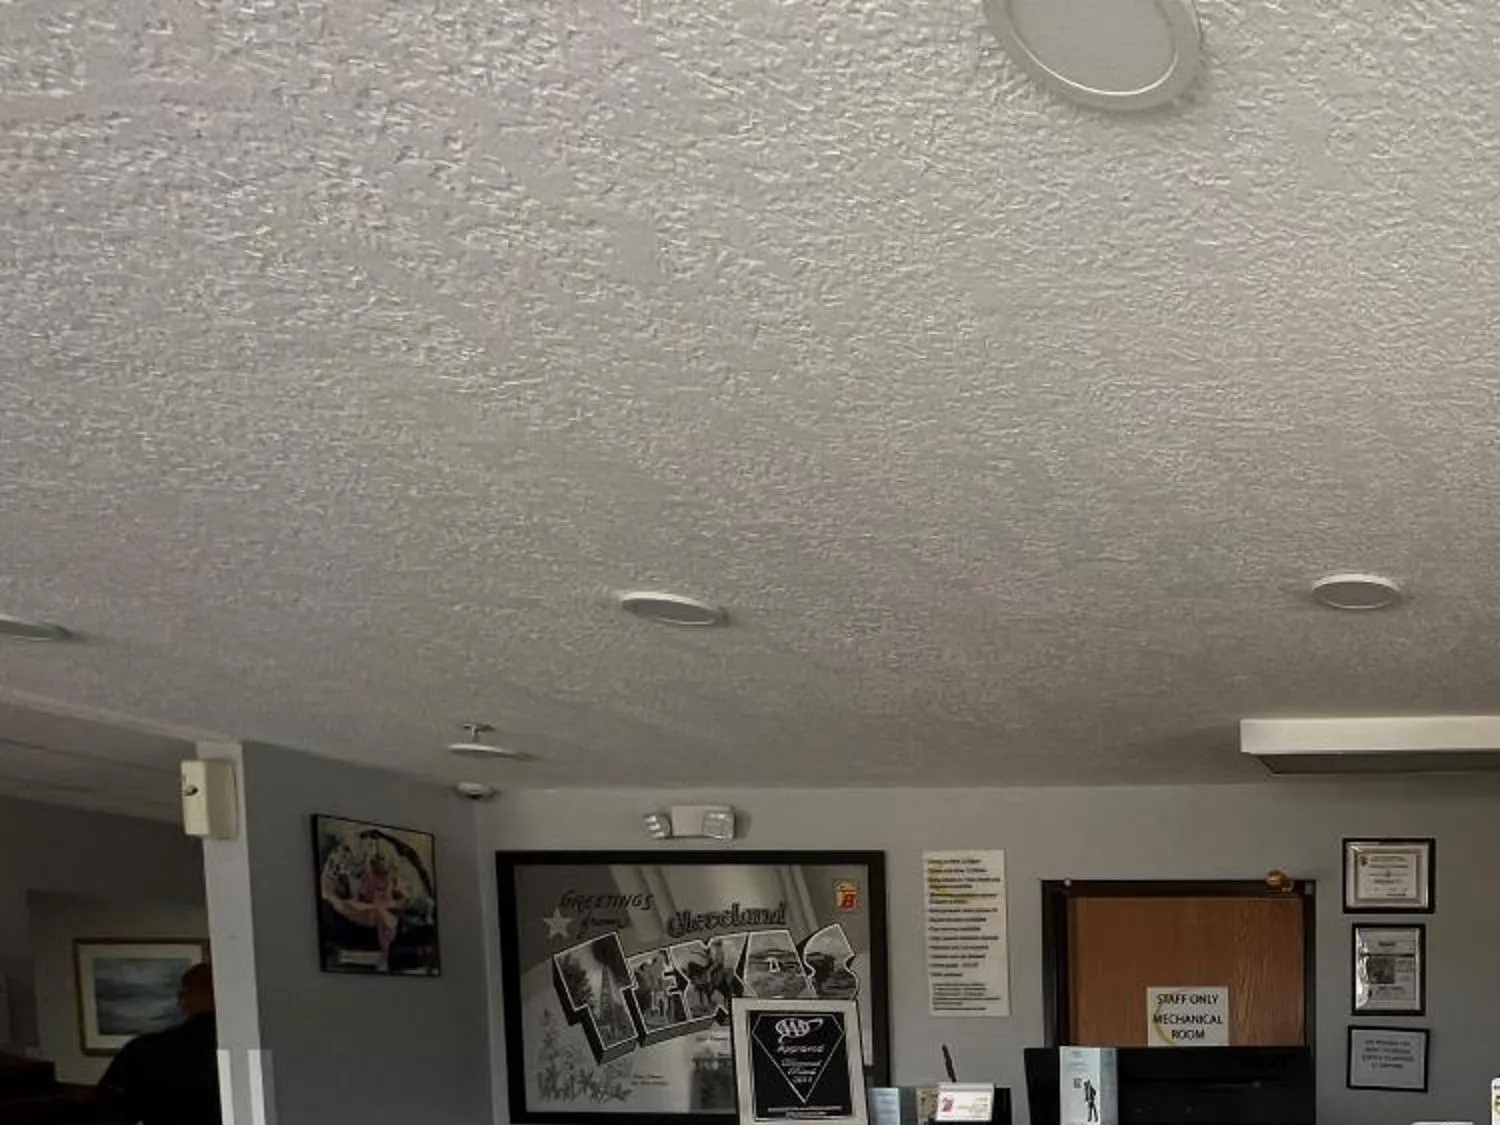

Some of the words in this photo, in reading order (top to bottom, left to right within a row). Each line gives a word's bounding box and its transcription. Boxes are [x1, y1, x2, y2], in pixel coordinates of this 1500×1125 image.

[560, 890, 655, 912] GREETINGS
[1157, 993, 1187, 1005] STAFF
[1189, 993, 1219, 1005] ONLY
[1153, 1013, 1223, 1025] MECHANICAL
[1171, 1029, 1205, 1041] ROOM
